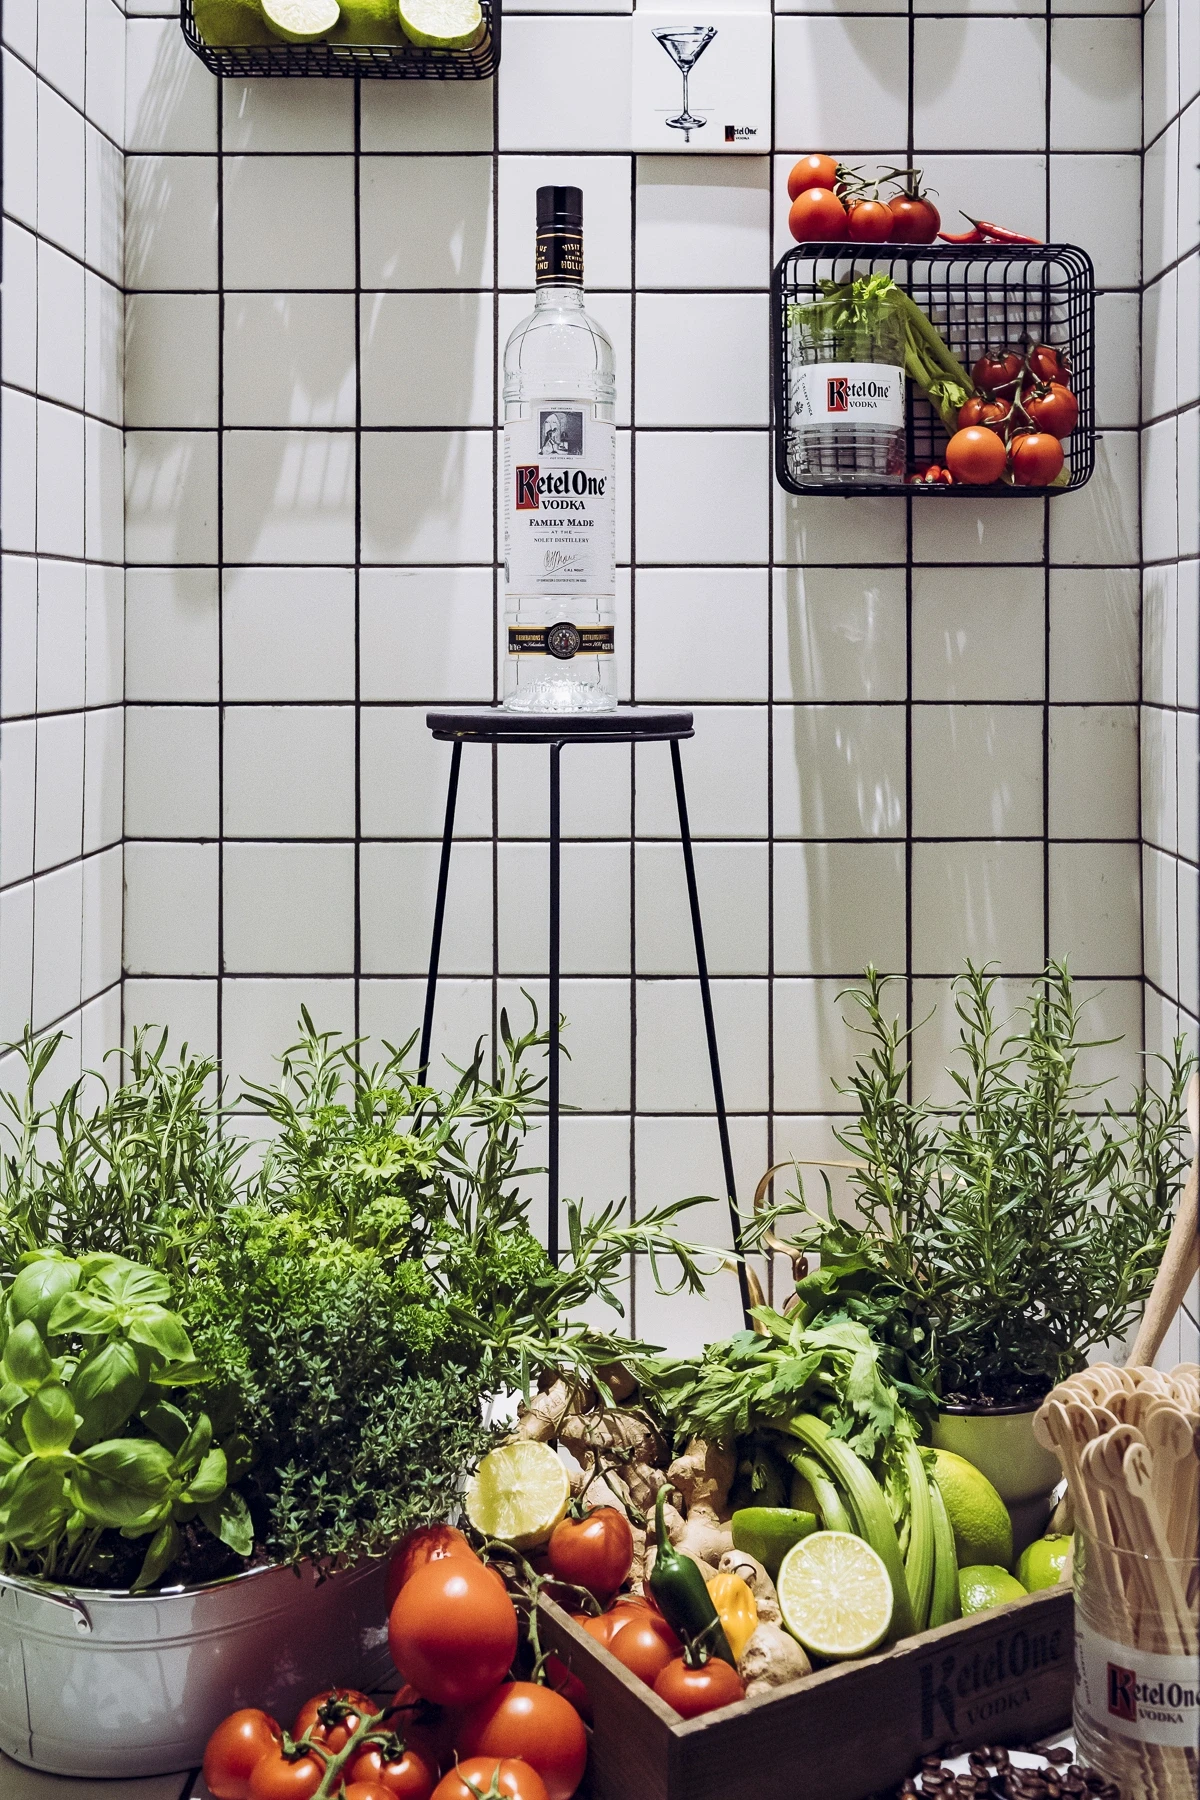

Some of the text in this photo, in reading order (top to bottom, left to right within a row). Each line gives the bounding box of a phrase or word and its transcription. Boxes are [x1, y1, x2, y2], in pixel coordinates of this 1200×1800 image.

[828, 379, 889, 410] Ketel One
[516, 468, 606, 507] Ketel One
[542, 500, 586, 510] VODKA
[529, 519, 595, 527] FAMILY MADE
[920, 1640, 1004, 1739] Ketel
[1008, 1629, 1064, 1677] One
[1108, 1664, 1166, 1720] Ketel
[967, 1687, 1031, 1726] VODKA
[1137, 1710, 1184, 1724] VODKA
